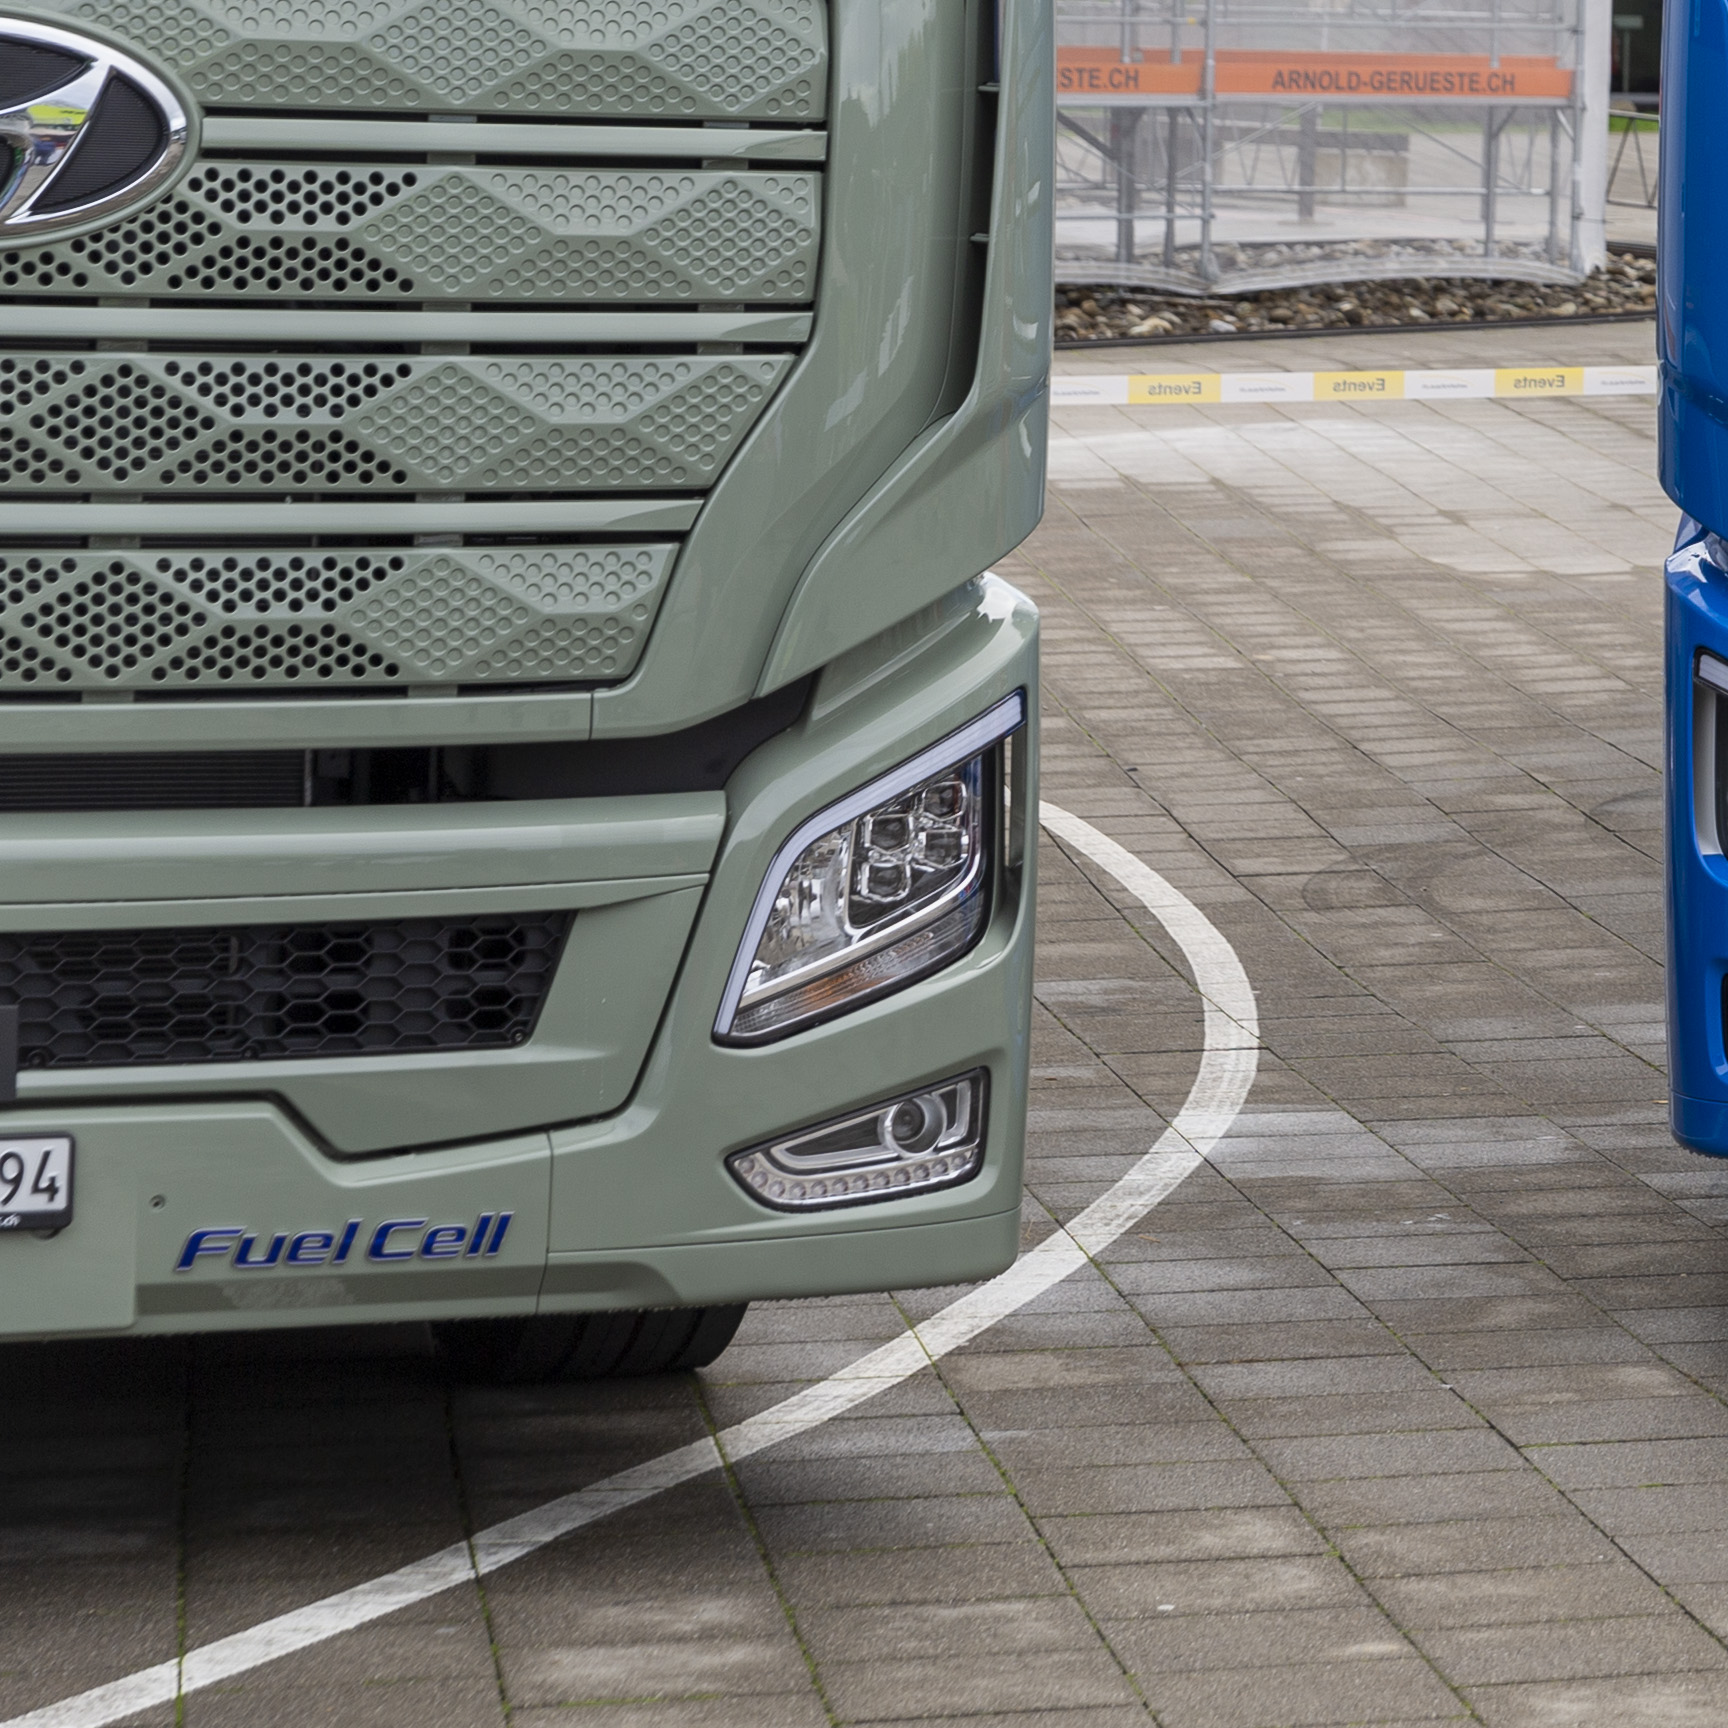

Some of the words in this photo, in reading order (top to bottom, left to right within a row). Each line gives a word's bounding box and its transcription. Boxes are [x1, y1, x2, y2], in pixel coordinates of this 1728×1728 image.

[1271, 69, 1516, 93] ARNOLD-GERUESTE.CH
[0, 1149, 60, 1207] 94
[174, 1217, 361, 1272] Fuel
[367, 1211, 516, 1261] Cell
